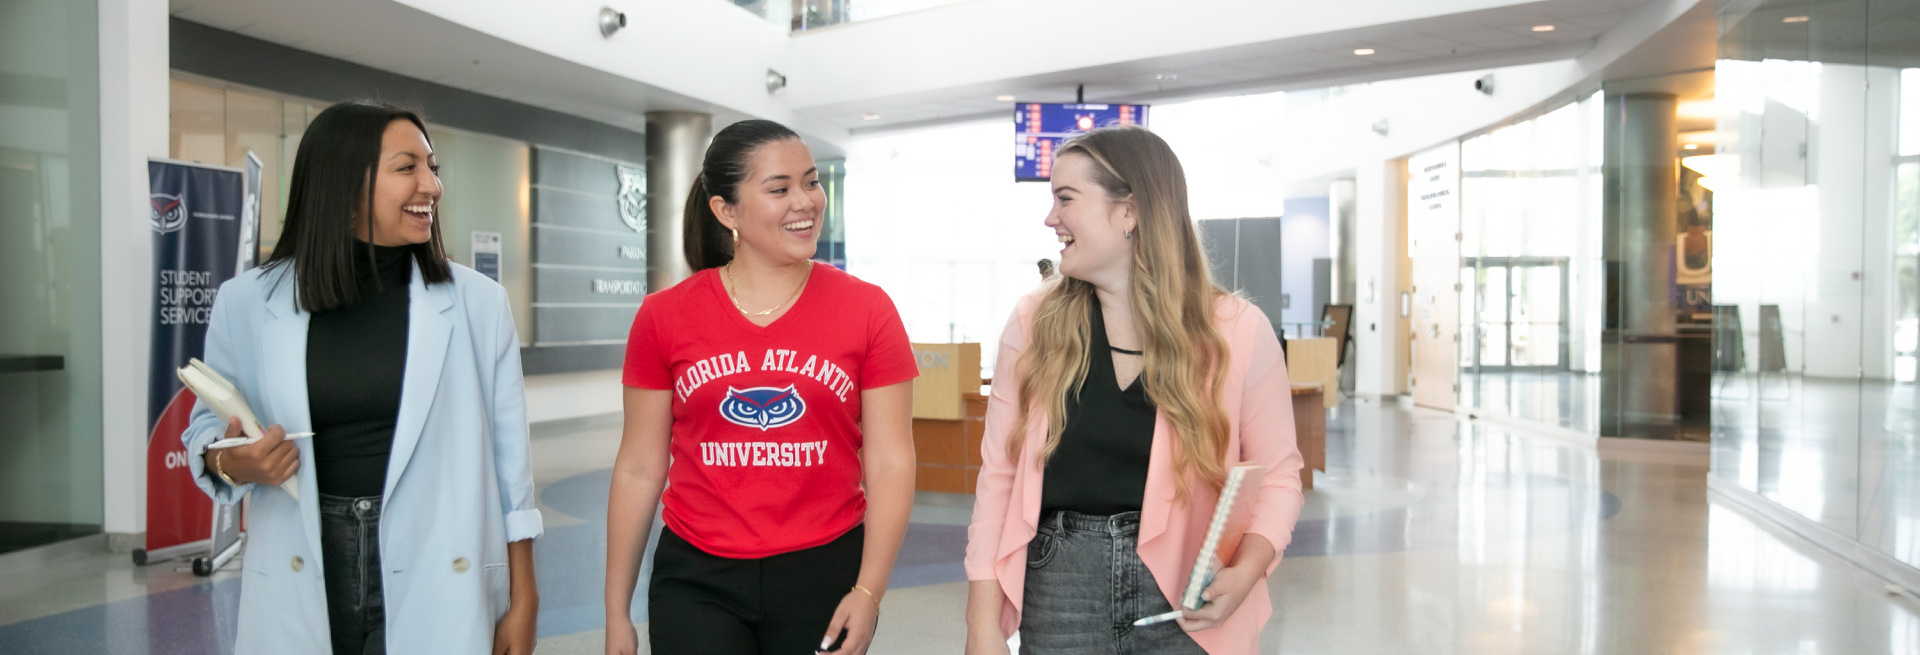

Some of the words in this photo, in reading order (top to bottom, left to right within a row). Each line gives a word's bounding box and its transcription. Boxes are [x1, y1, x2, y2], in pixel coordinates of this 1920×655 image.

[161, 270, 211, 286] STUDENT
[161, 287, 218, 306] SUPPORT
[676, 351, 751, 403] FLORIDA
[761, 349, 855, 403] ATLANTIC
[700, 440, 828, 467] UNIVERSITY
